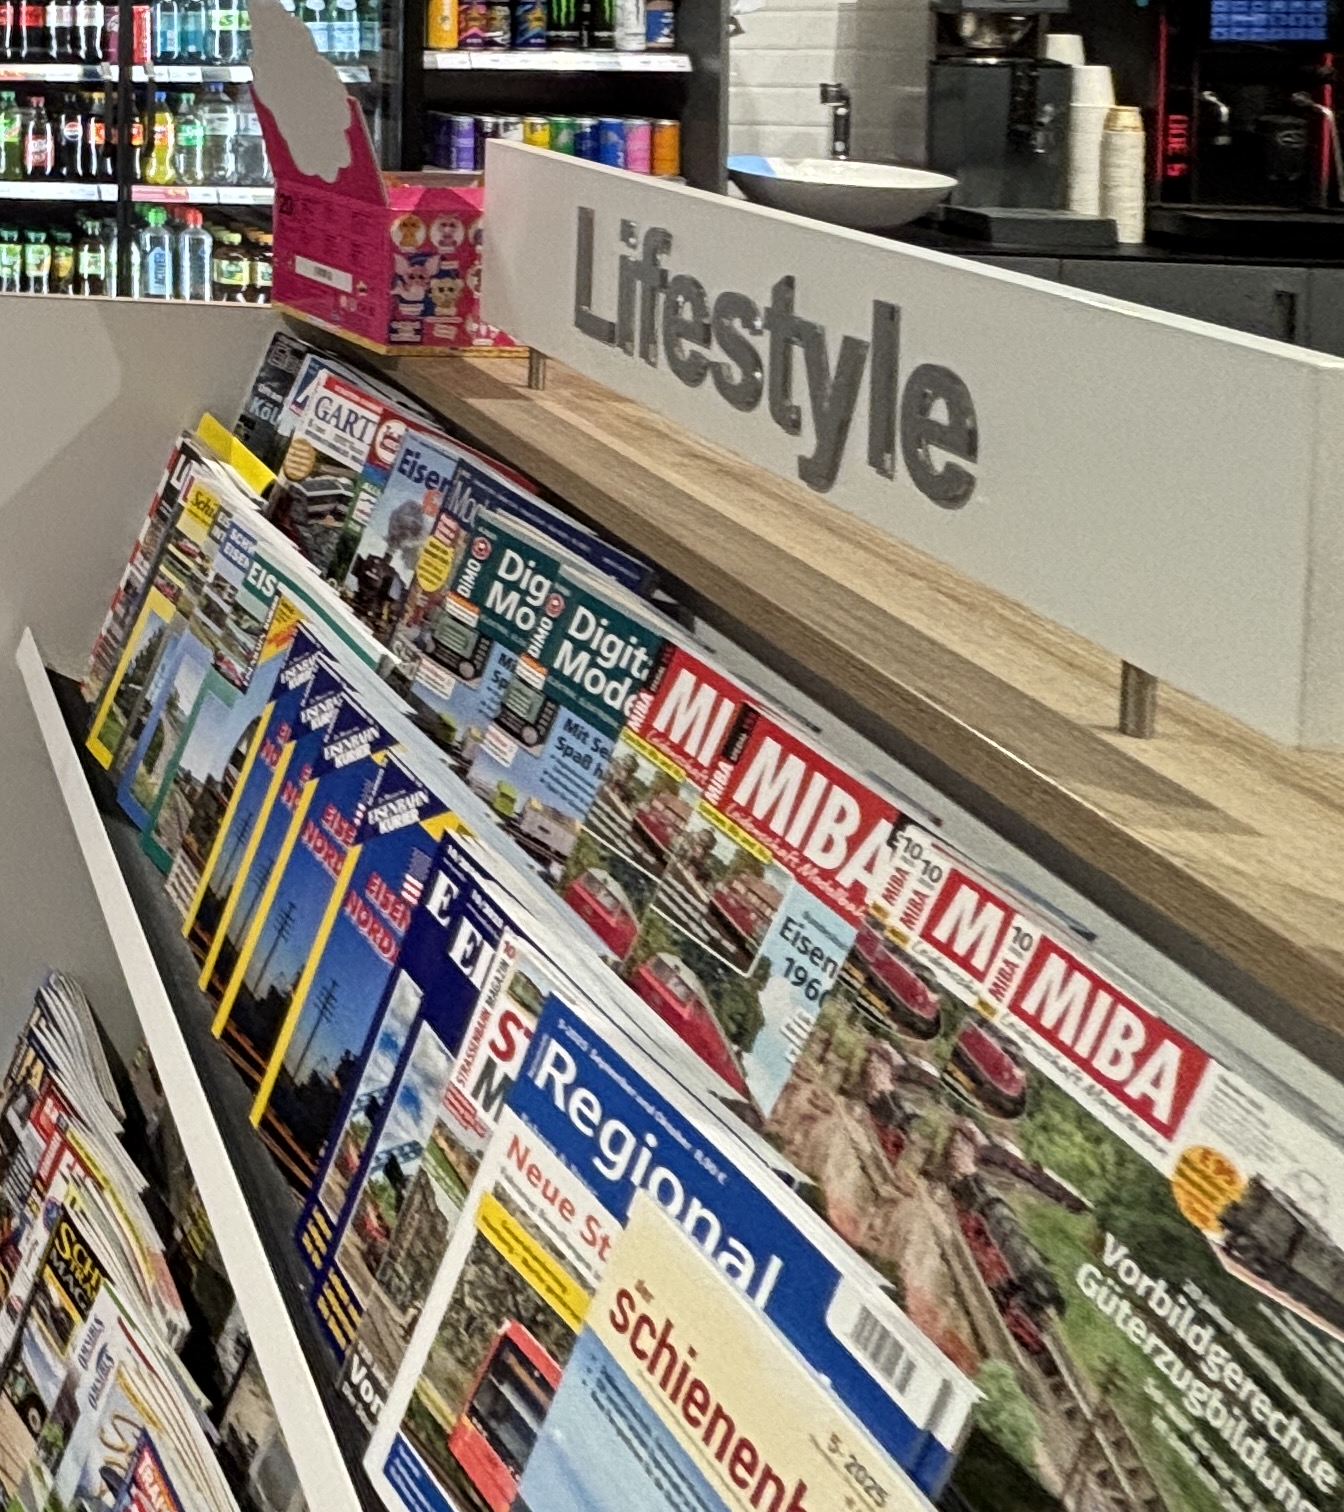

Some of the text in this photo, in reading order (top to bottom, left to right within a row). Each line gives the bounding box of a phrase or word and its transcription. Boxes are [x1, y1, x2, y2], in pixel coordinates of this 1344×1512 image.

[573, 206, 979, 510] Lifestyle
[732, 737, 899, 900] MIBA
[1021, 951, 1187, 1128] MIBA
[505, 1133, 576, 1221] Neue
[535, 1037, 784, 1310] Regional
[1102, 1230, 1340, 1497] Vorbildgerechte
